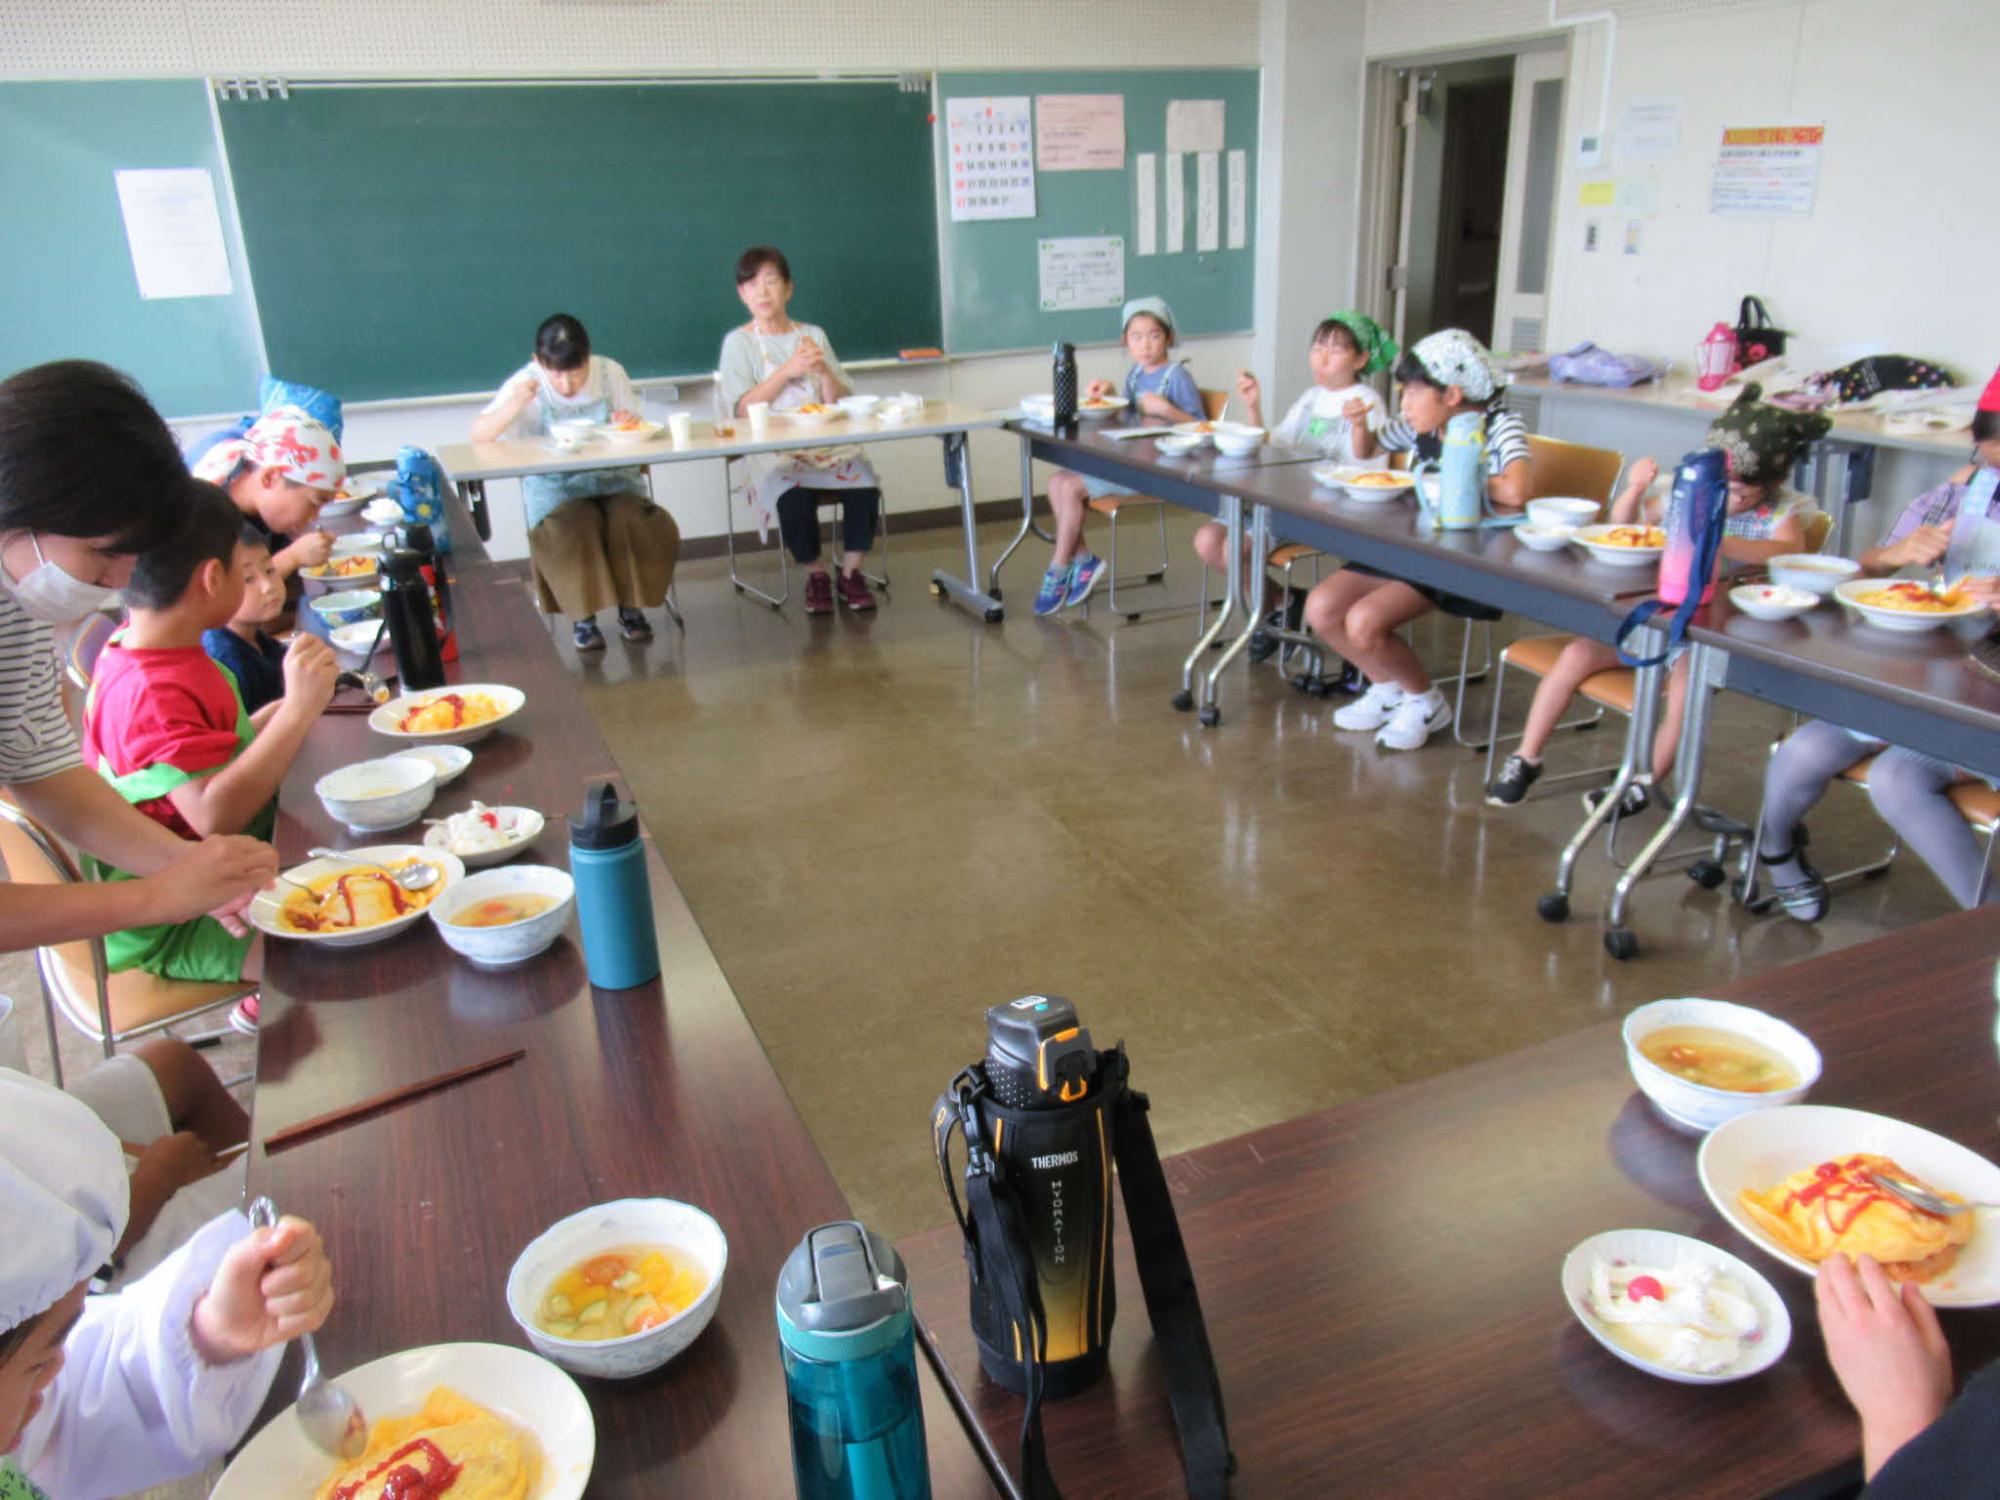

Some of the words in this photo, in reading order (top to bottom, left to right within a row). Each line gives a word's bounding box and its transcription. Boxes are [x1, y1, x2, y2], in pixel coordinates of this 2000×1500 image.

[987, 124, 993, 134] 2
[1031, 1151, 1078, 1169] THERMOS
[1051, 1180, 1065, 1264] HYDRATION
